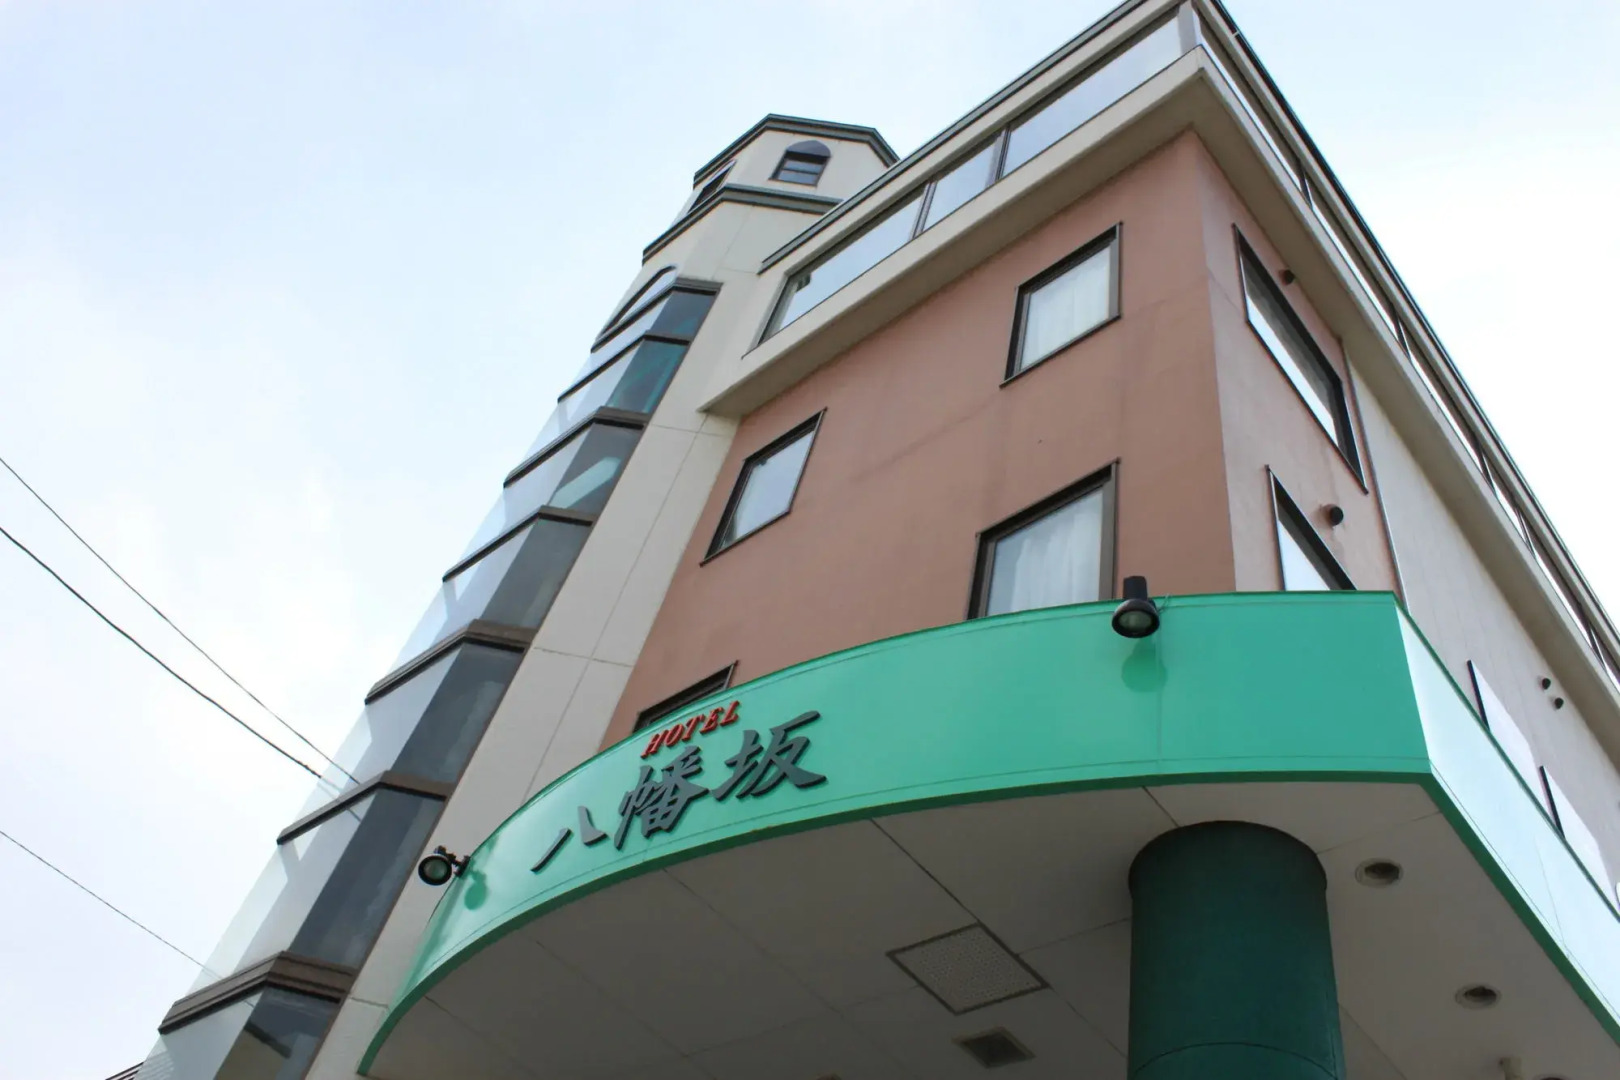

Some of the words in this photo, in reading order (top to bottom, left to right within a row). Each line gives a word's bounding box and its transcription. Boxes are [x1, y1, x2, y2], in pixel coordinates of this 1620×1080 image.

[640, 700, 740, 759] HOTEL
[531, 710, 827, 873] 八幡坂
